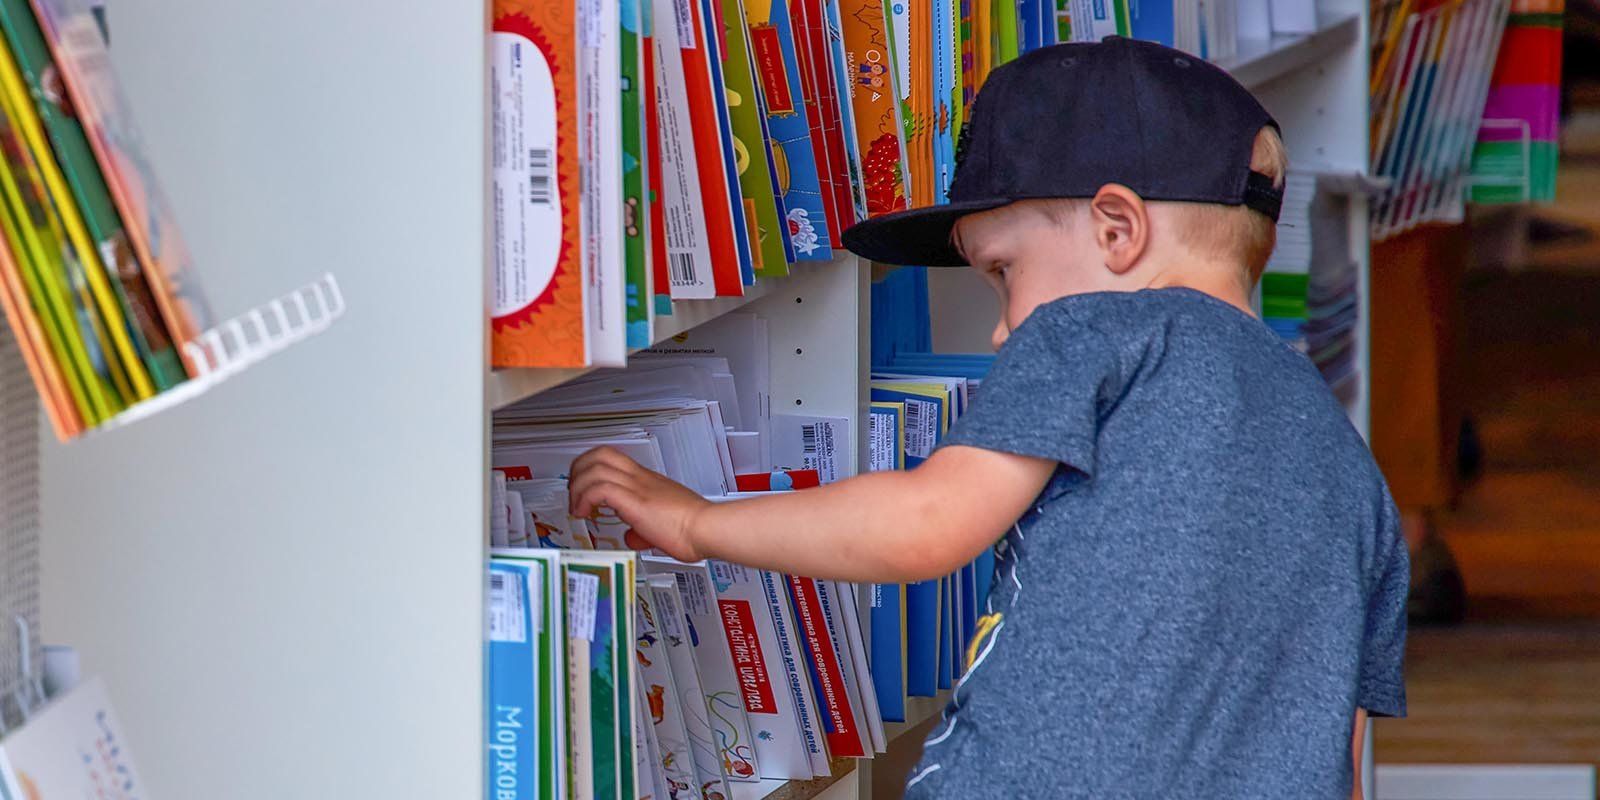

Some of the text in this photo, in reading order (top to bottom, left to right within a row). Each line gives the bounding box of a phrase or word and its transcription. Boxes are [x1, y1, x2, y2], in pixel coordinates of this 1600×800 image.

[772, 605, 793, 656] математика
[785, 656, 797, 672] для
[796, 585, 816, 636] математика
[808, 636, 822, 653] для
[815, 653, 838, 709] современных
[830, 709, 848, 734] детей
[790, 673, 811, 729] современных
[804, 729, 820, 754] детей
